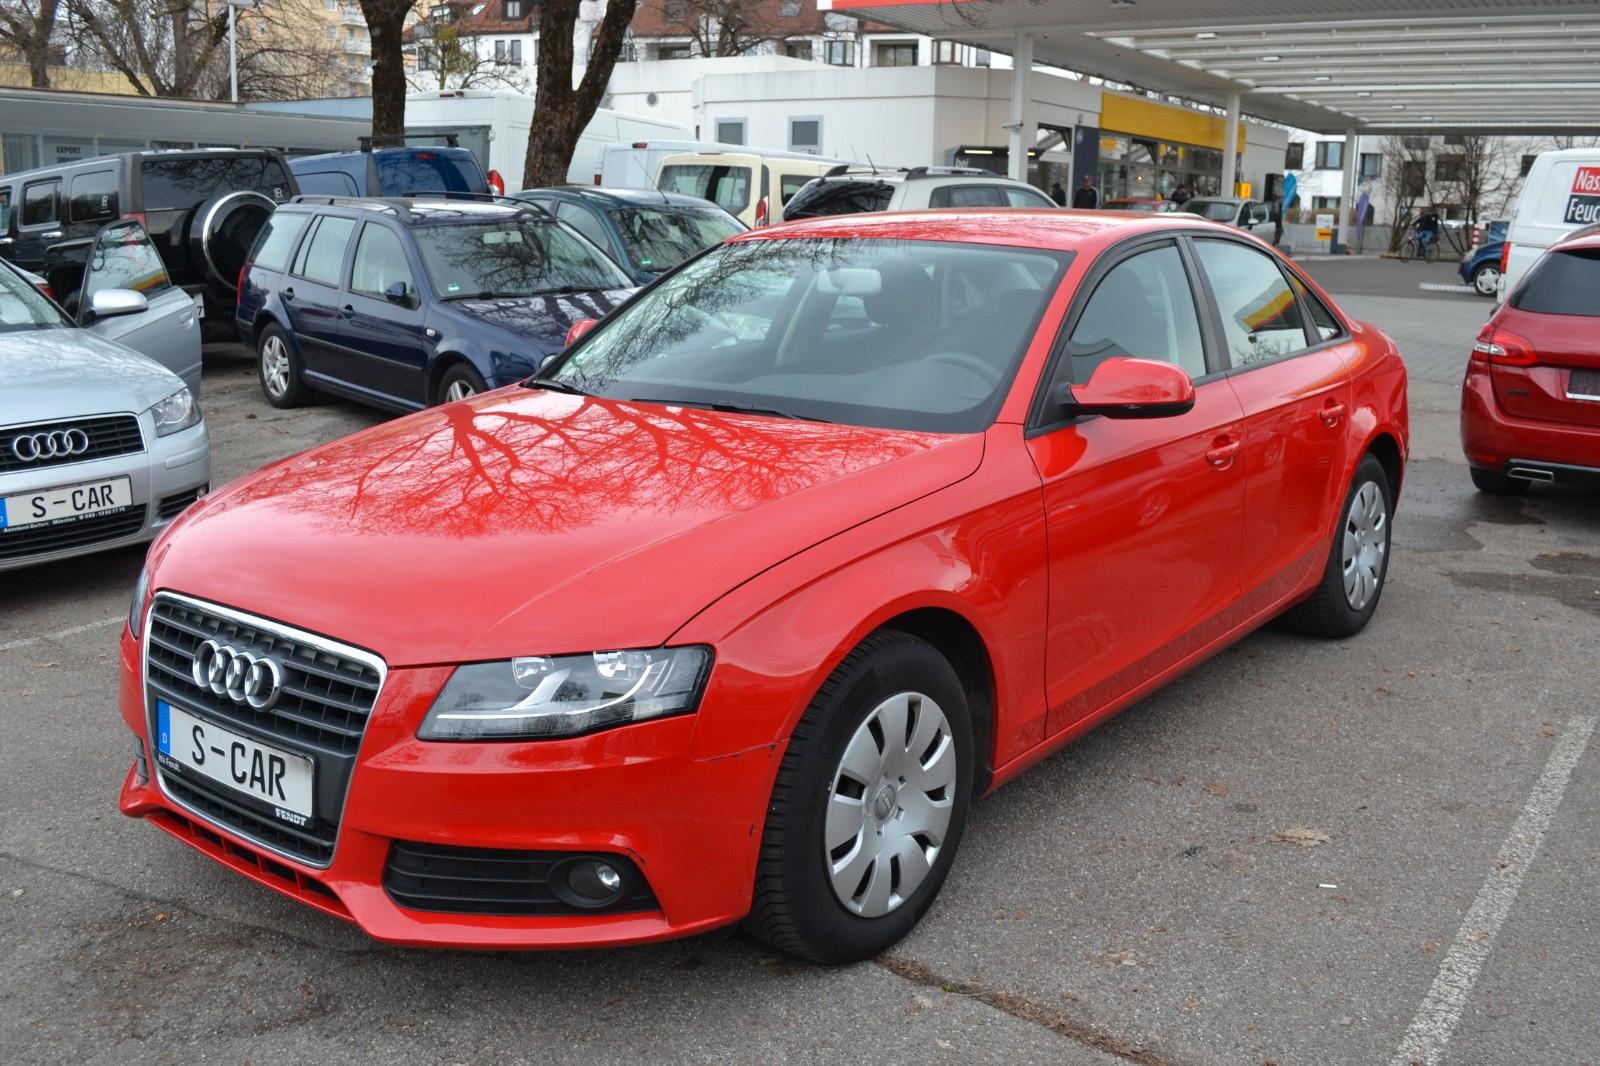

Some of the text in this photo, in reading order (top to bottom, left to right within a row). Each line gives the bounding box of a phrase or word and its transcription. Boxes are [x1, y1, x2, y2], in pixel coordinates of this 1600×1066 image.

[1575, 169, 1600, 191] Nas
[1567, 198, 1600, 222] Feuc
[162, 732, 168, 744] D
[275, 807, 307, 827] FENDT
